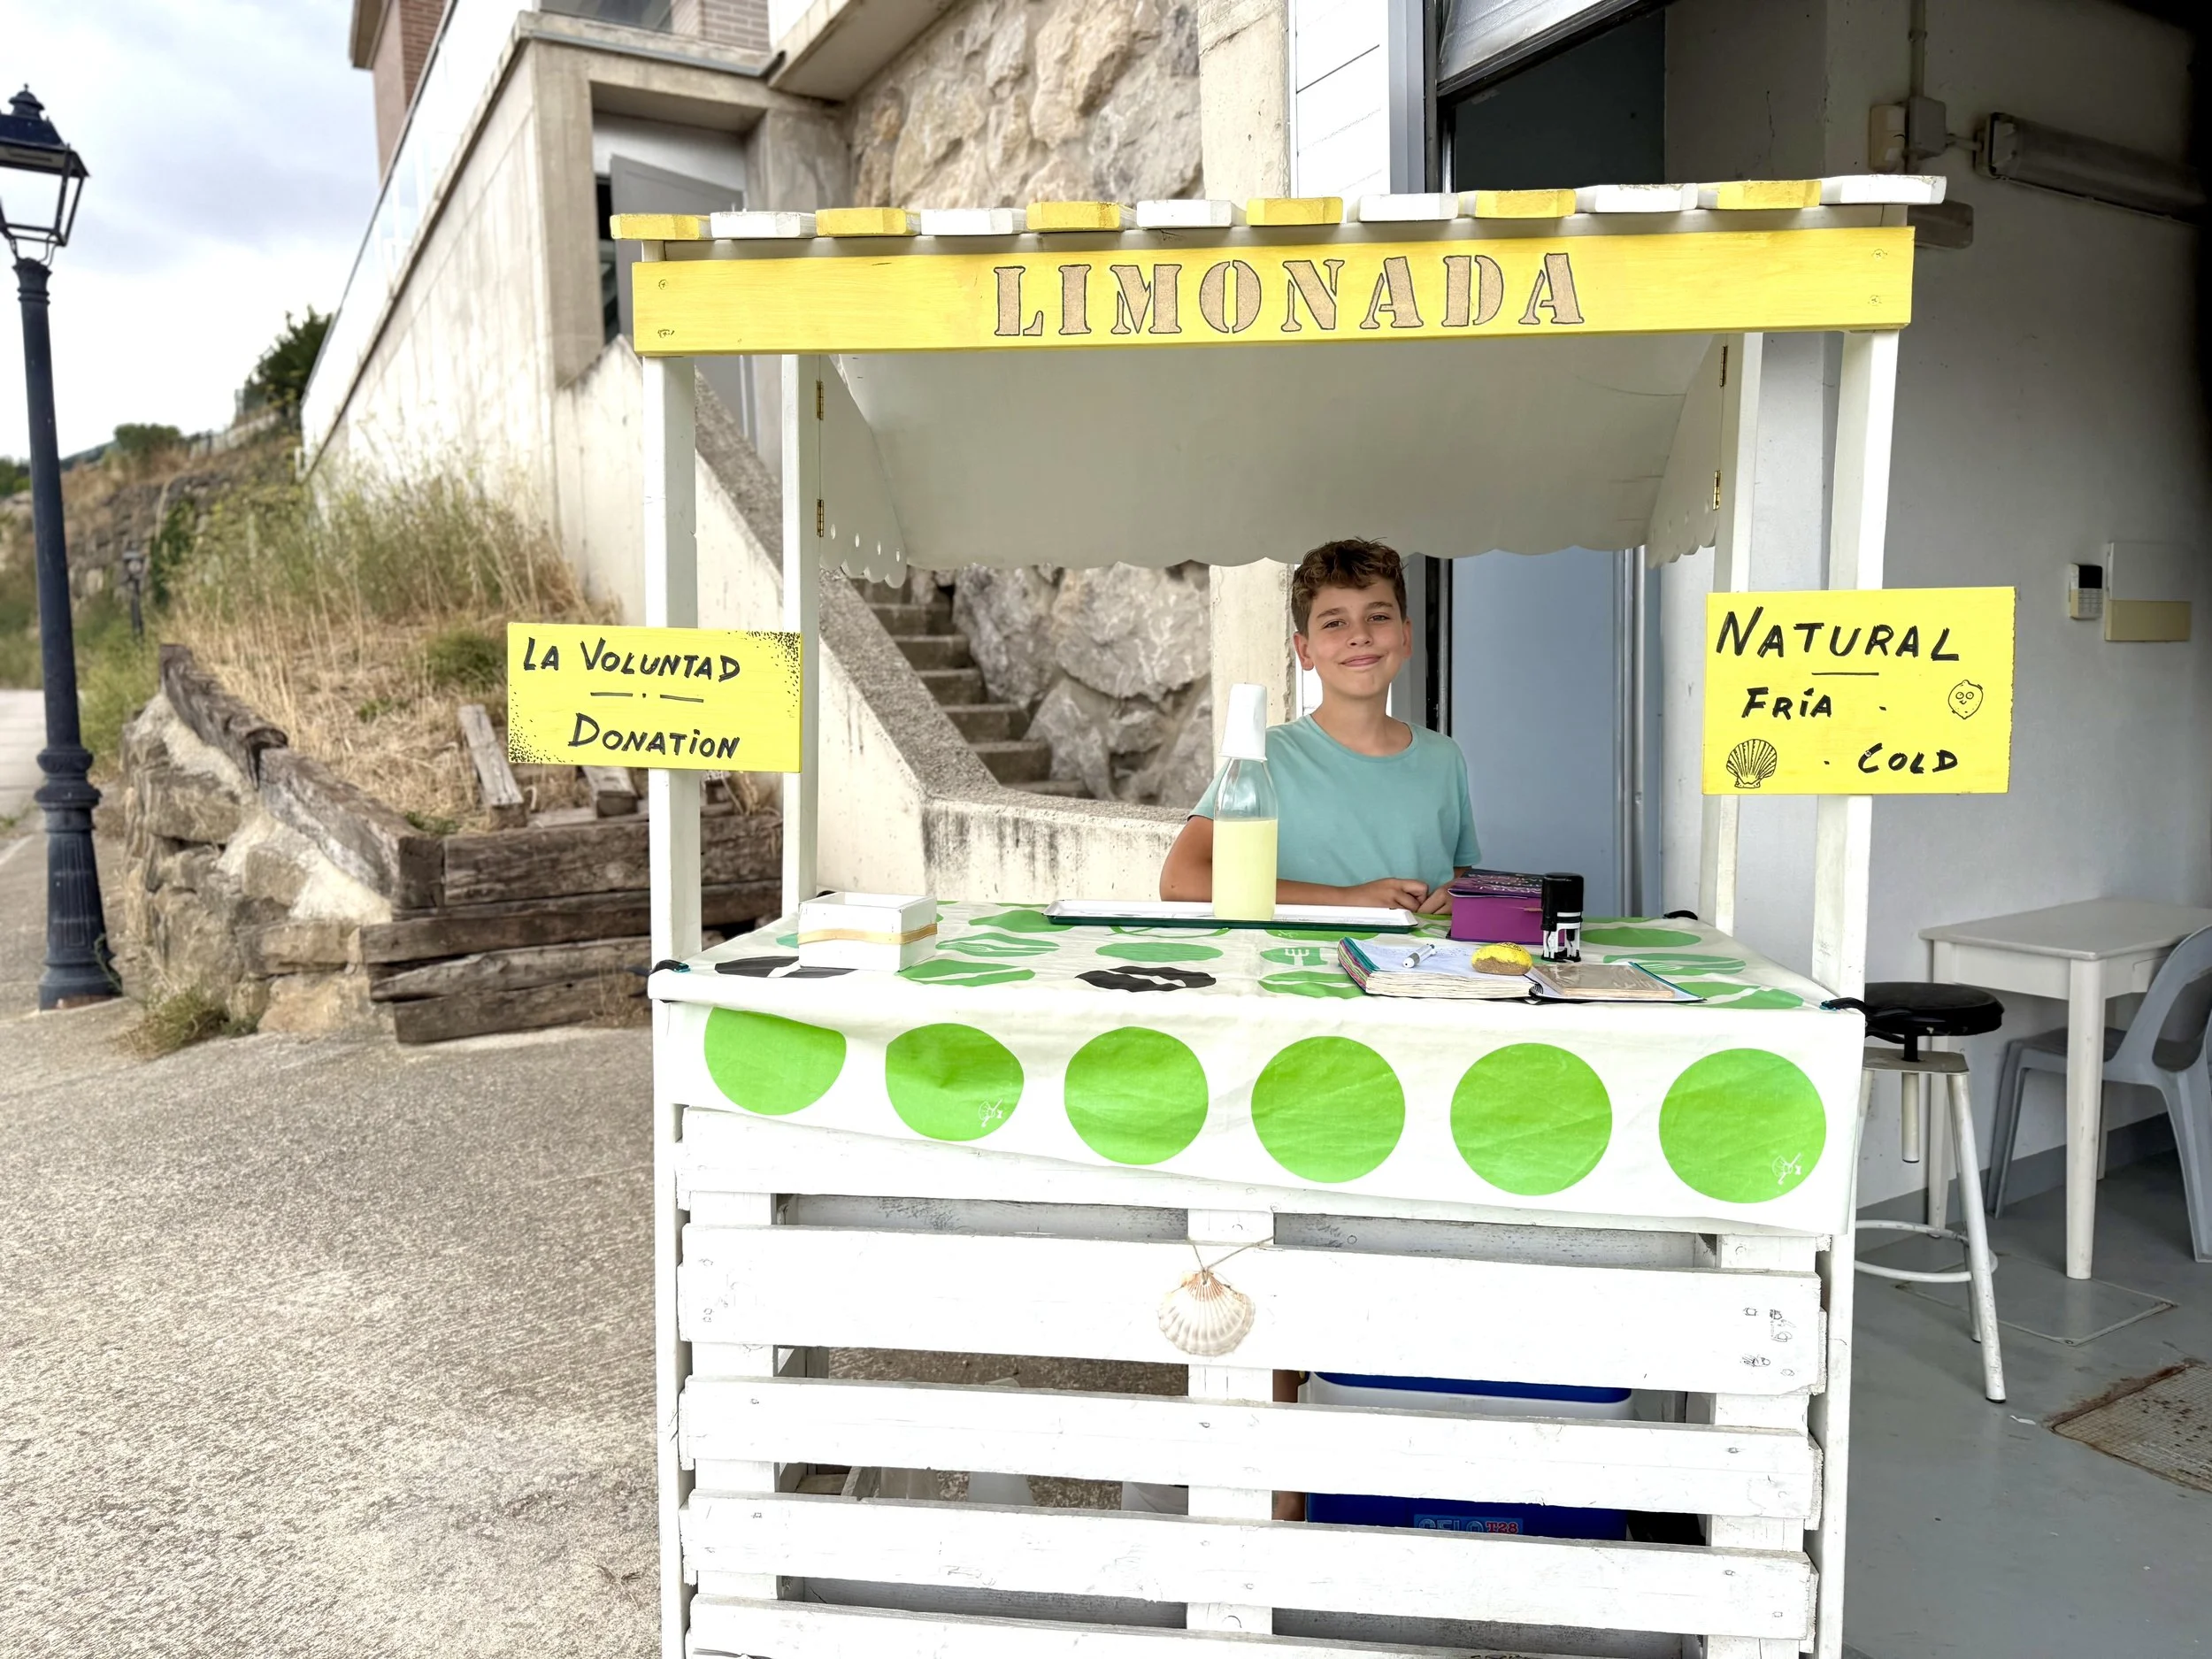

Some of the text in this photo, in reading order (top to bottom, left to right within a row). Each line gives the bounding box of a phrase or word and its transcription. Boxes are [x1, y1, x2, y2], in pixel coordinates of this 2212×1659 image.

[994, 252, 1585, 336] LIMONADA
[1717, 607, 1959, 661] NATURAL
[524, 637, 740, 682] LA VOLUNTAD
[1858, 743, 1957, 773] COLD
[1486, 1521, 1518, 1534] T28
